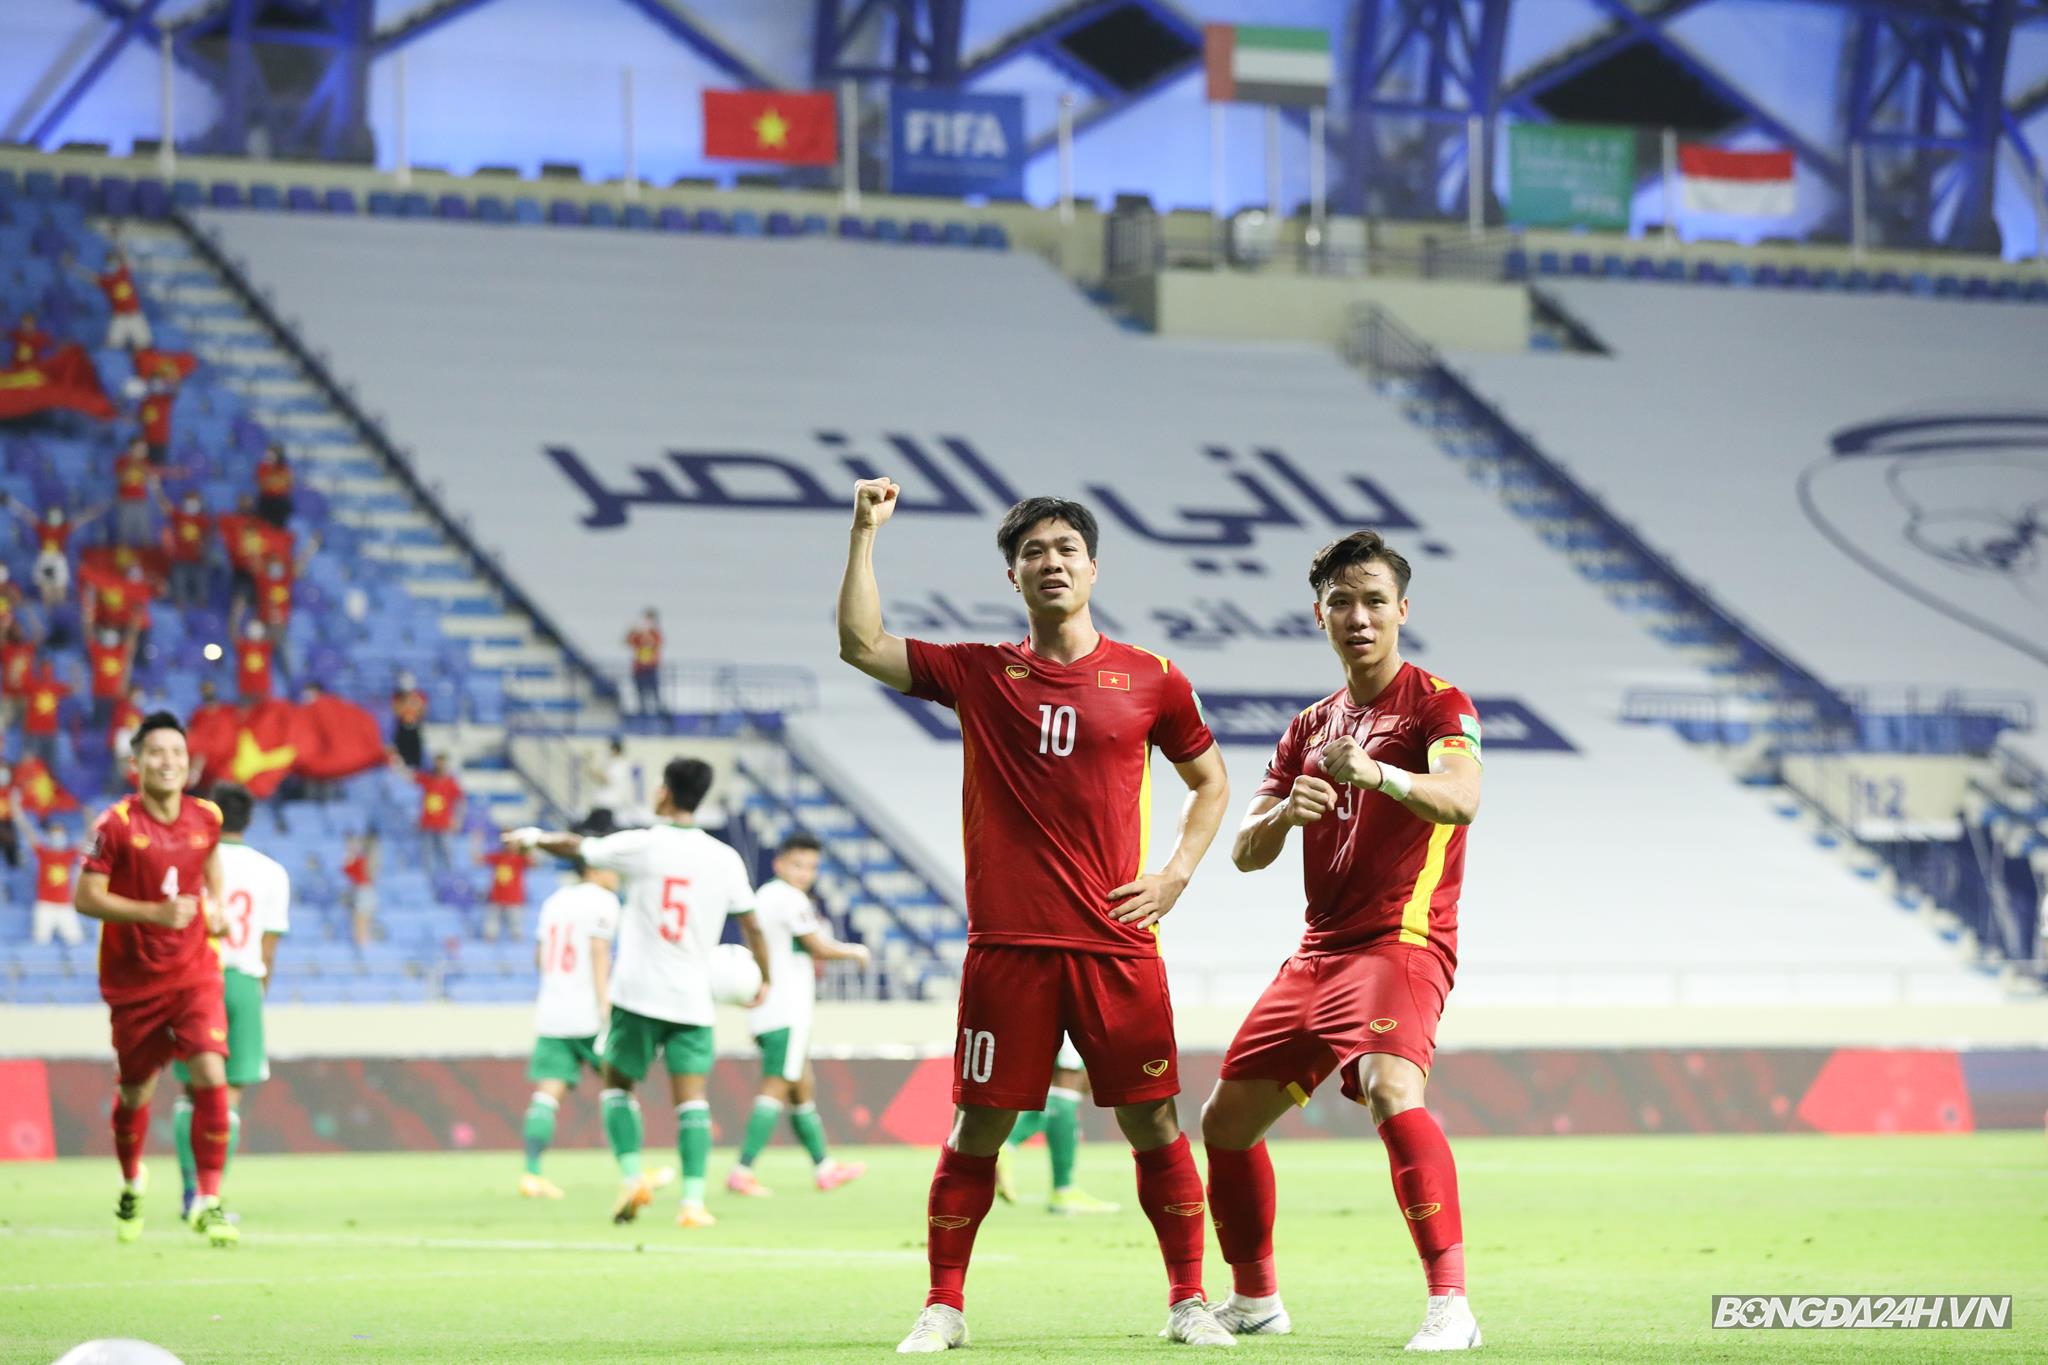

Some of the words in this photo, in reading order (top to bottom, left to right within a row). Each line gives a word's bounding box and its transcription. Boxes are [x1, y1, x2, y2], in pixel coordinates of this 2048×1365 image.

[904, 110, 1008, 158] FIFA
[1038, 704, 1077, 757] 10
[160, 865, 180, 901] 4
[659, 876, 690, 943] 5
[543, 921, 577, 974] 16
[962, 1028, 996, 1083] 10
